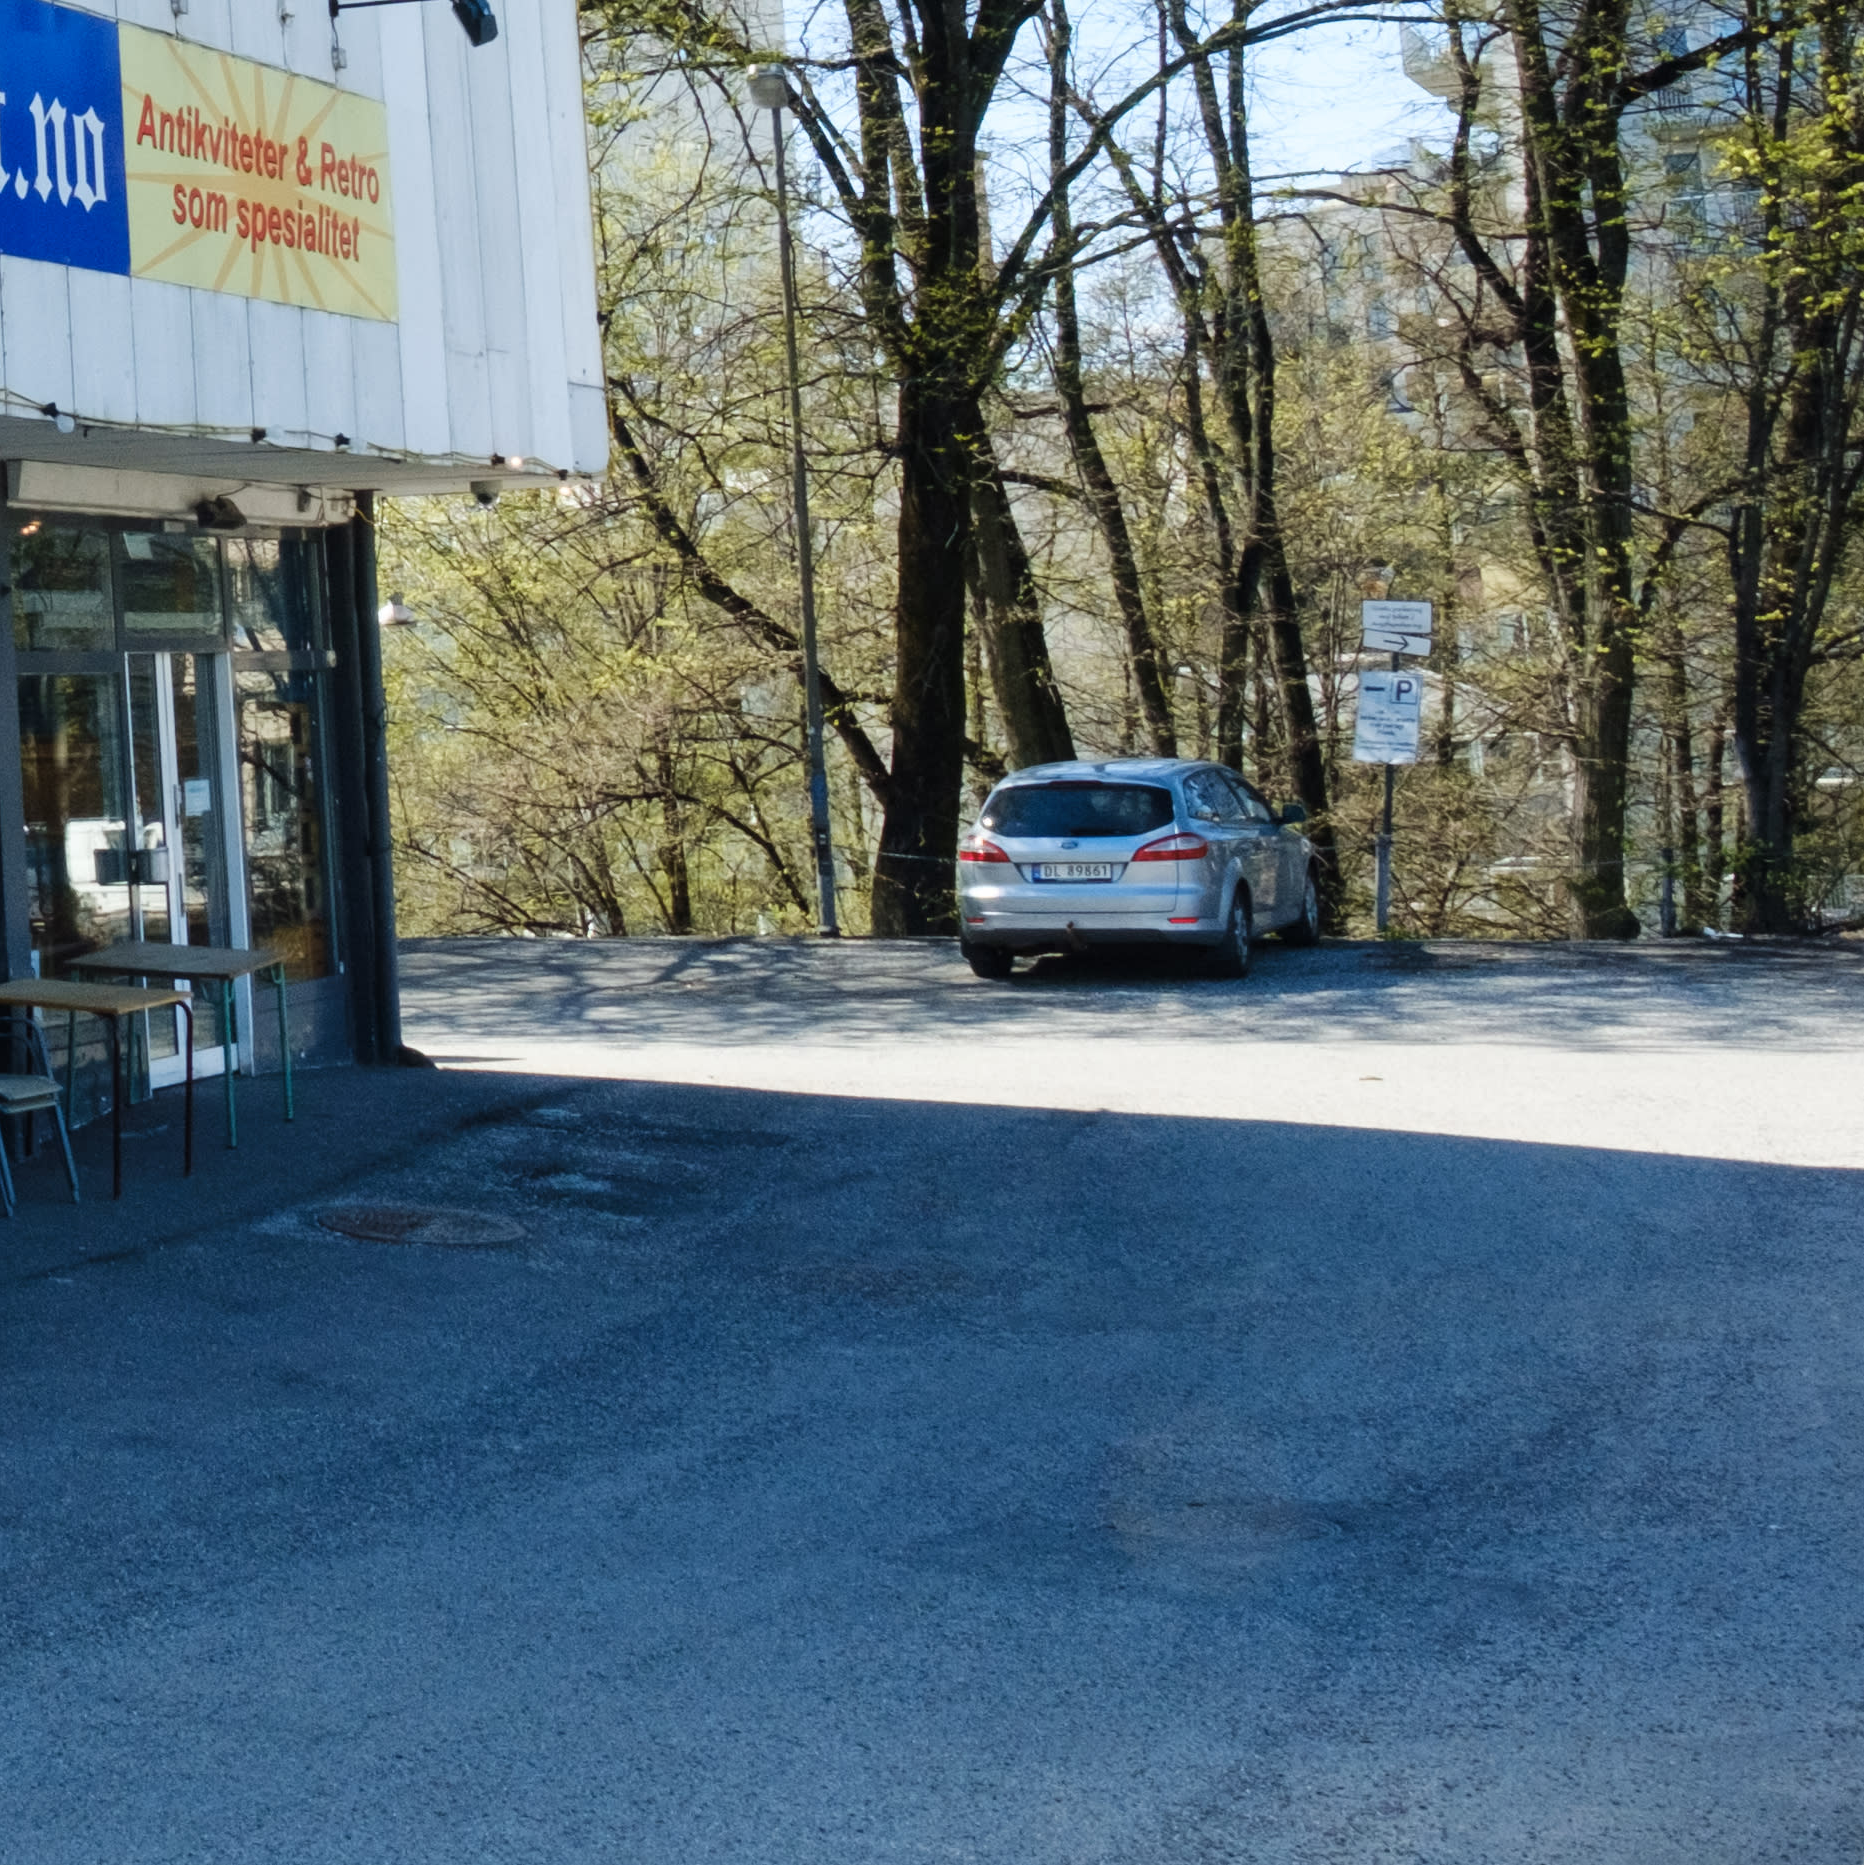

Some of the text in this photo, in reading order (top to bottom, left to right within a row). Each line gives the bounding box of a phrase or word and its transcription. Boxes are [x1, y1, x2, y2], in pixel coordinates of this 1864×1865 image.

[137, 93, 380, 205] Antikviteter & Retro
[172, 183, 360, 262] som spesialitet
[1395, 679, 1413, 701] P
